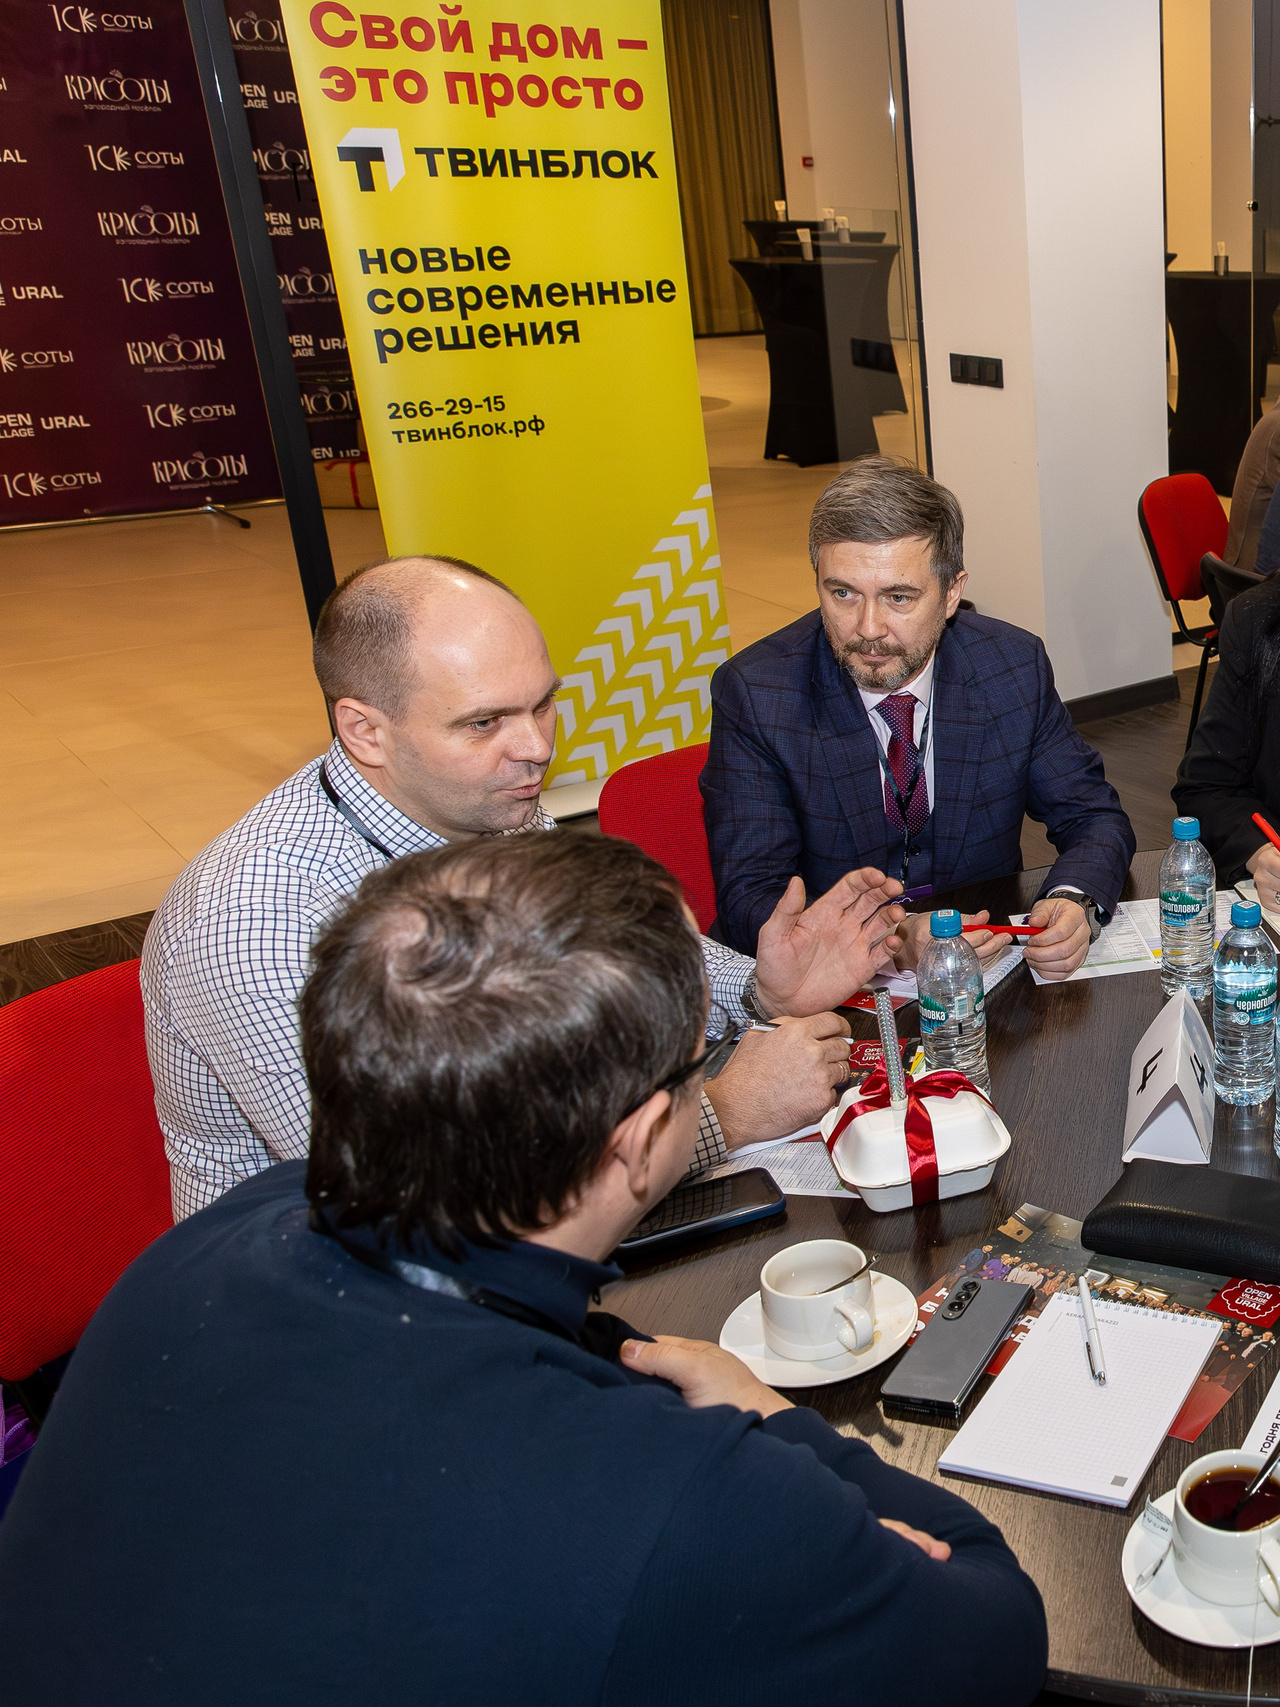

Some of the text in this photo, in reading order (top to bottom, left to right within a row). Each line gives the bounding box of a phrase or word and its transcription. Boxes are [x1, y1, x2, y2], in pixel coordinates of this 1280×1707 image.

[101, 13, 153, 30] СОТЫ
[309, 1, 474, 54] Свой
[489, 23, 603, 63] дом
[319, 66, 644, 117] это просто
[134, 151, 184, 164] СОТЫ
[414, 147, 659, 179] ТВИНБЛОК
[0, 217, 43, 231] ОТЫ
[358, 246, 511, 275] новые
[12, 286, 64, 300] URAL
[166, 281, 214, 294] СОТЫ
[366, 279, 677, 321] современные
[374, 320, 581, 364] решения
[21, 350, 74, 364] СОТЫ
[190, 404, 236, 418] СОТЫ
[388, 395, 506, 420] 266-29-15
[0, 413, 32, 427] PEN
[40, 414, 91, 430] URAL
[392, 415, 545, 444] твинблок.рф
[50, 472, 102, 487] СОТЫ
[1242, 1292, 1268, 1303] VILLAGE
[1244, 1287, 1272, 1300] OPEN
[1235, 1298, 1261, 1310] URAL
[1097, 1318, 1119, 1326] ARAZZI
[1260, 1422, 1280, 1454] ГОДНЯ
